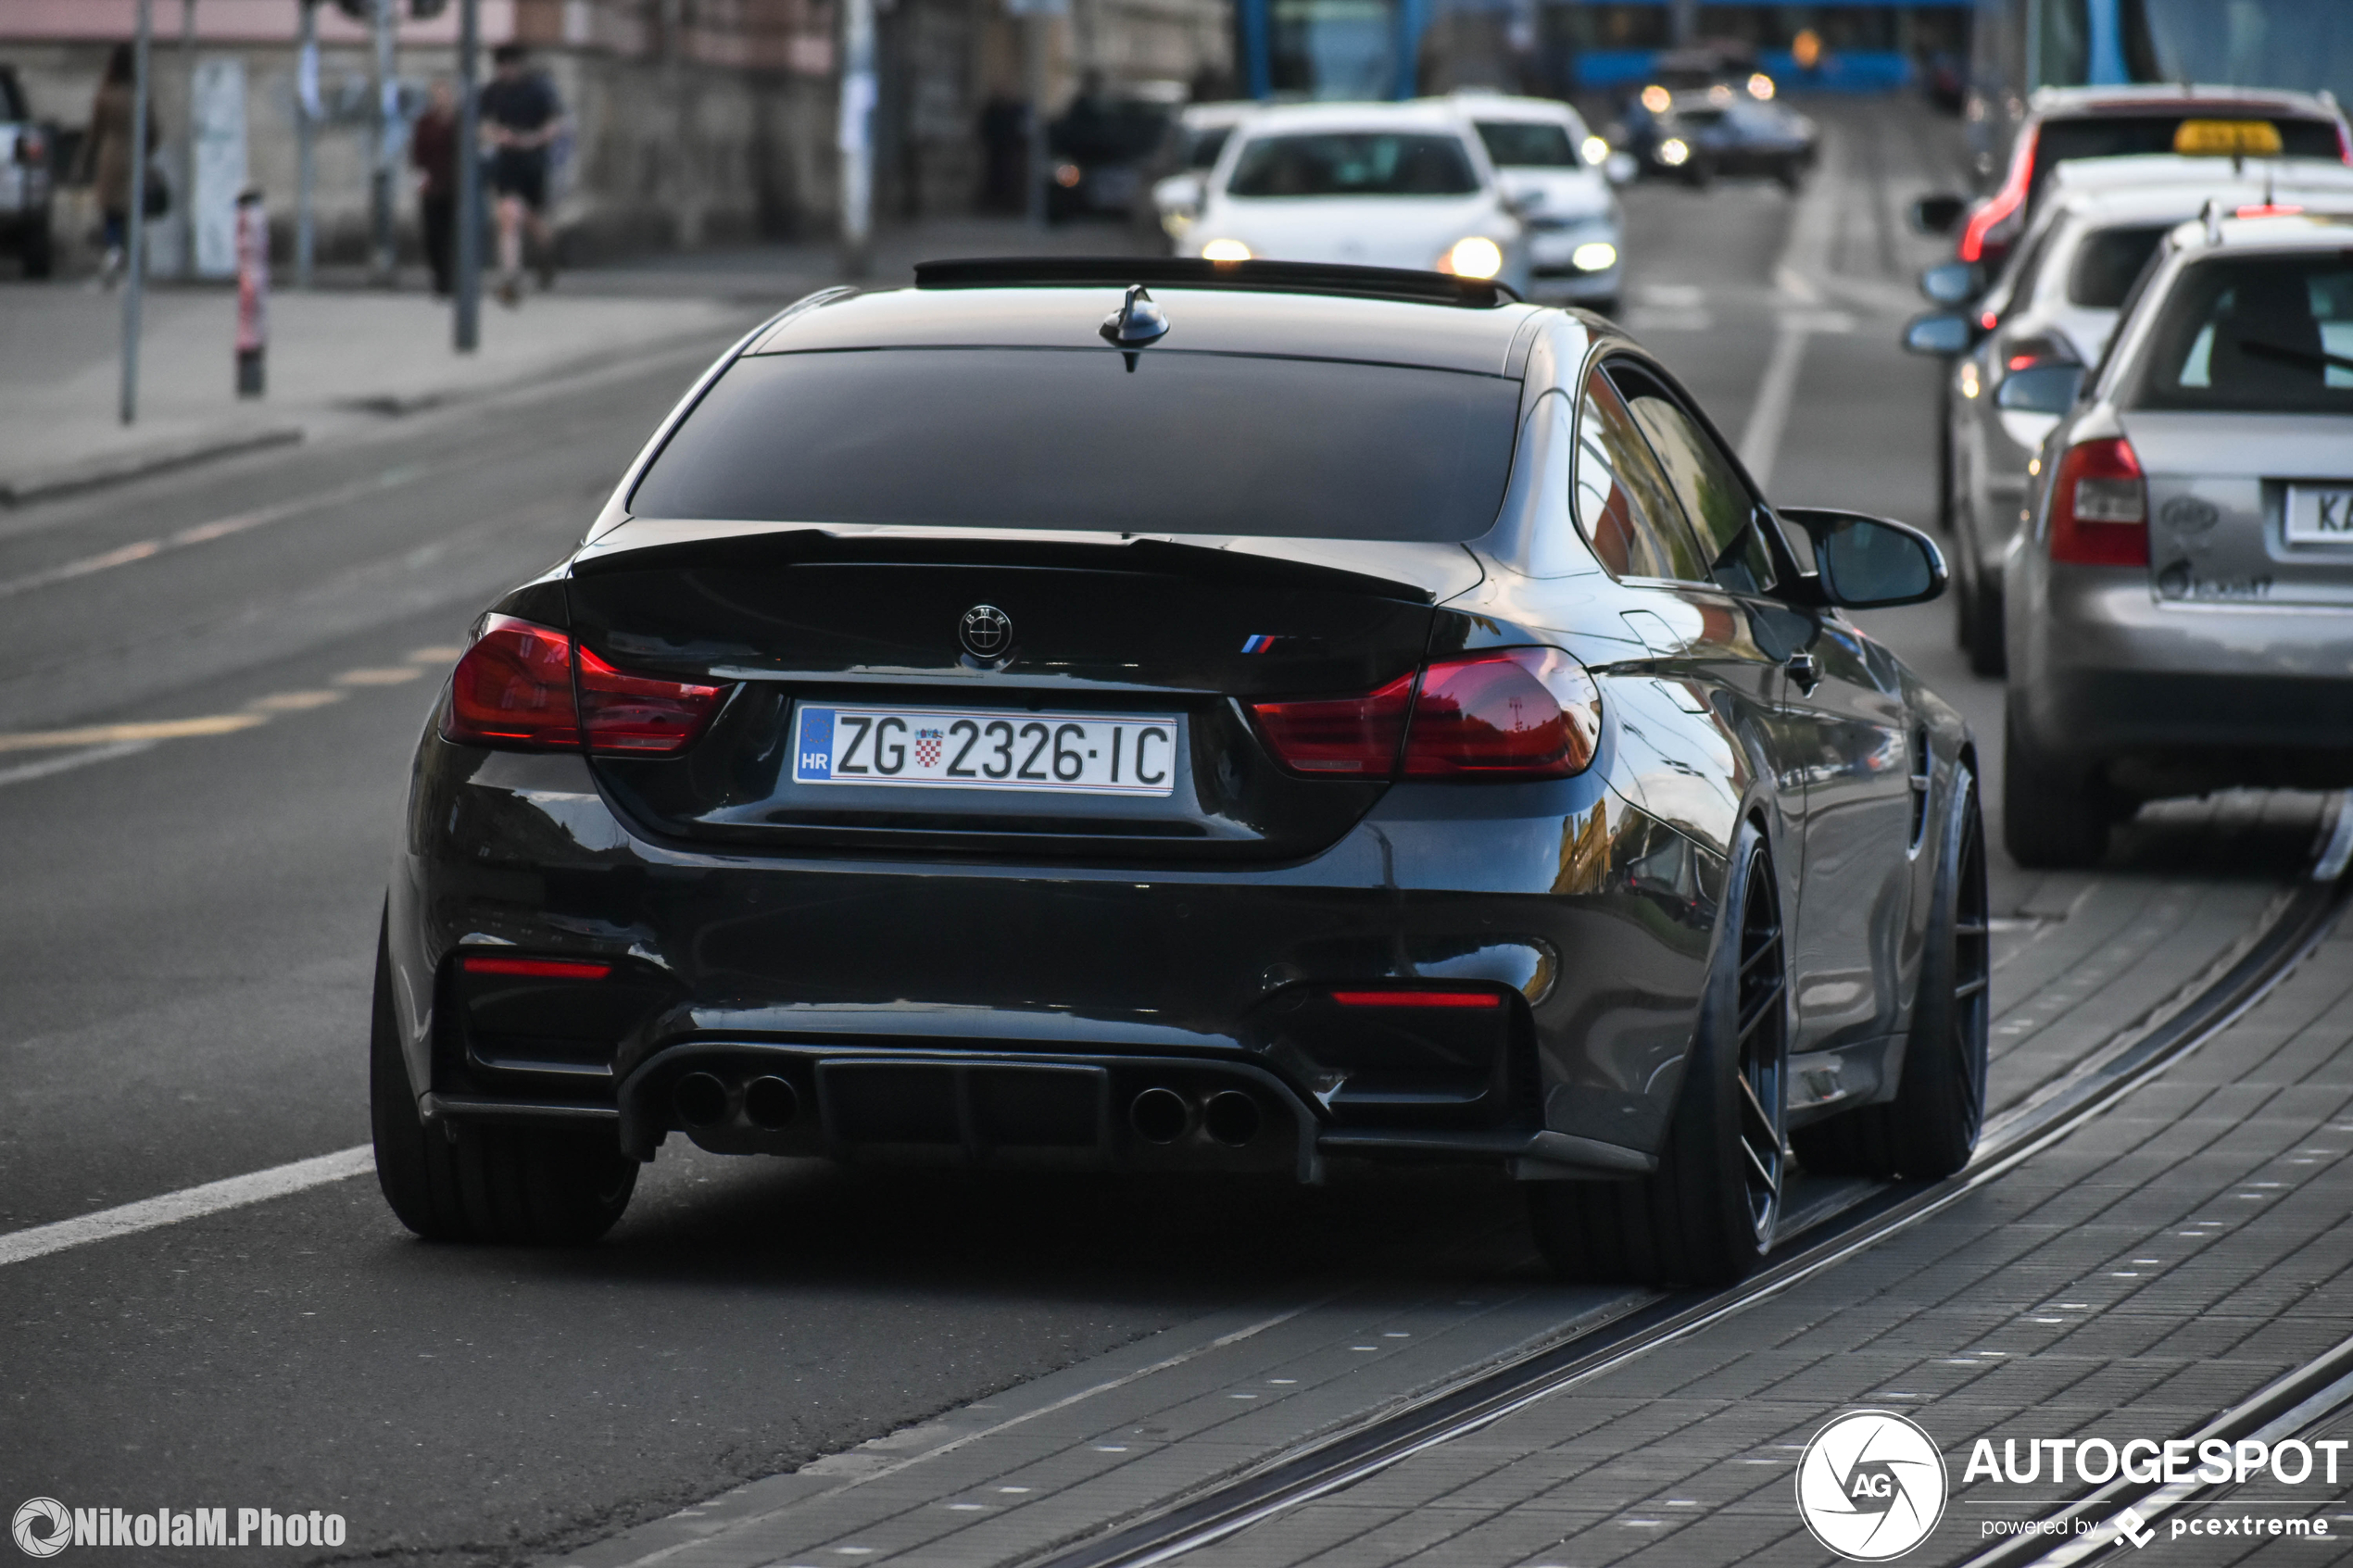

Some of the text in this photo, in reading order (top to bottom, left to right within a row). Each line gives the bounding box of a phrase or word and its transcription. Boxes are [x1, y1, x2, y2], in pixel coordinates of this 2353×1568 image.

[965, 608, 1006, 625] BMW
[837, 716, 907, 775] ZG
[801, 753, 828, 770] HR
